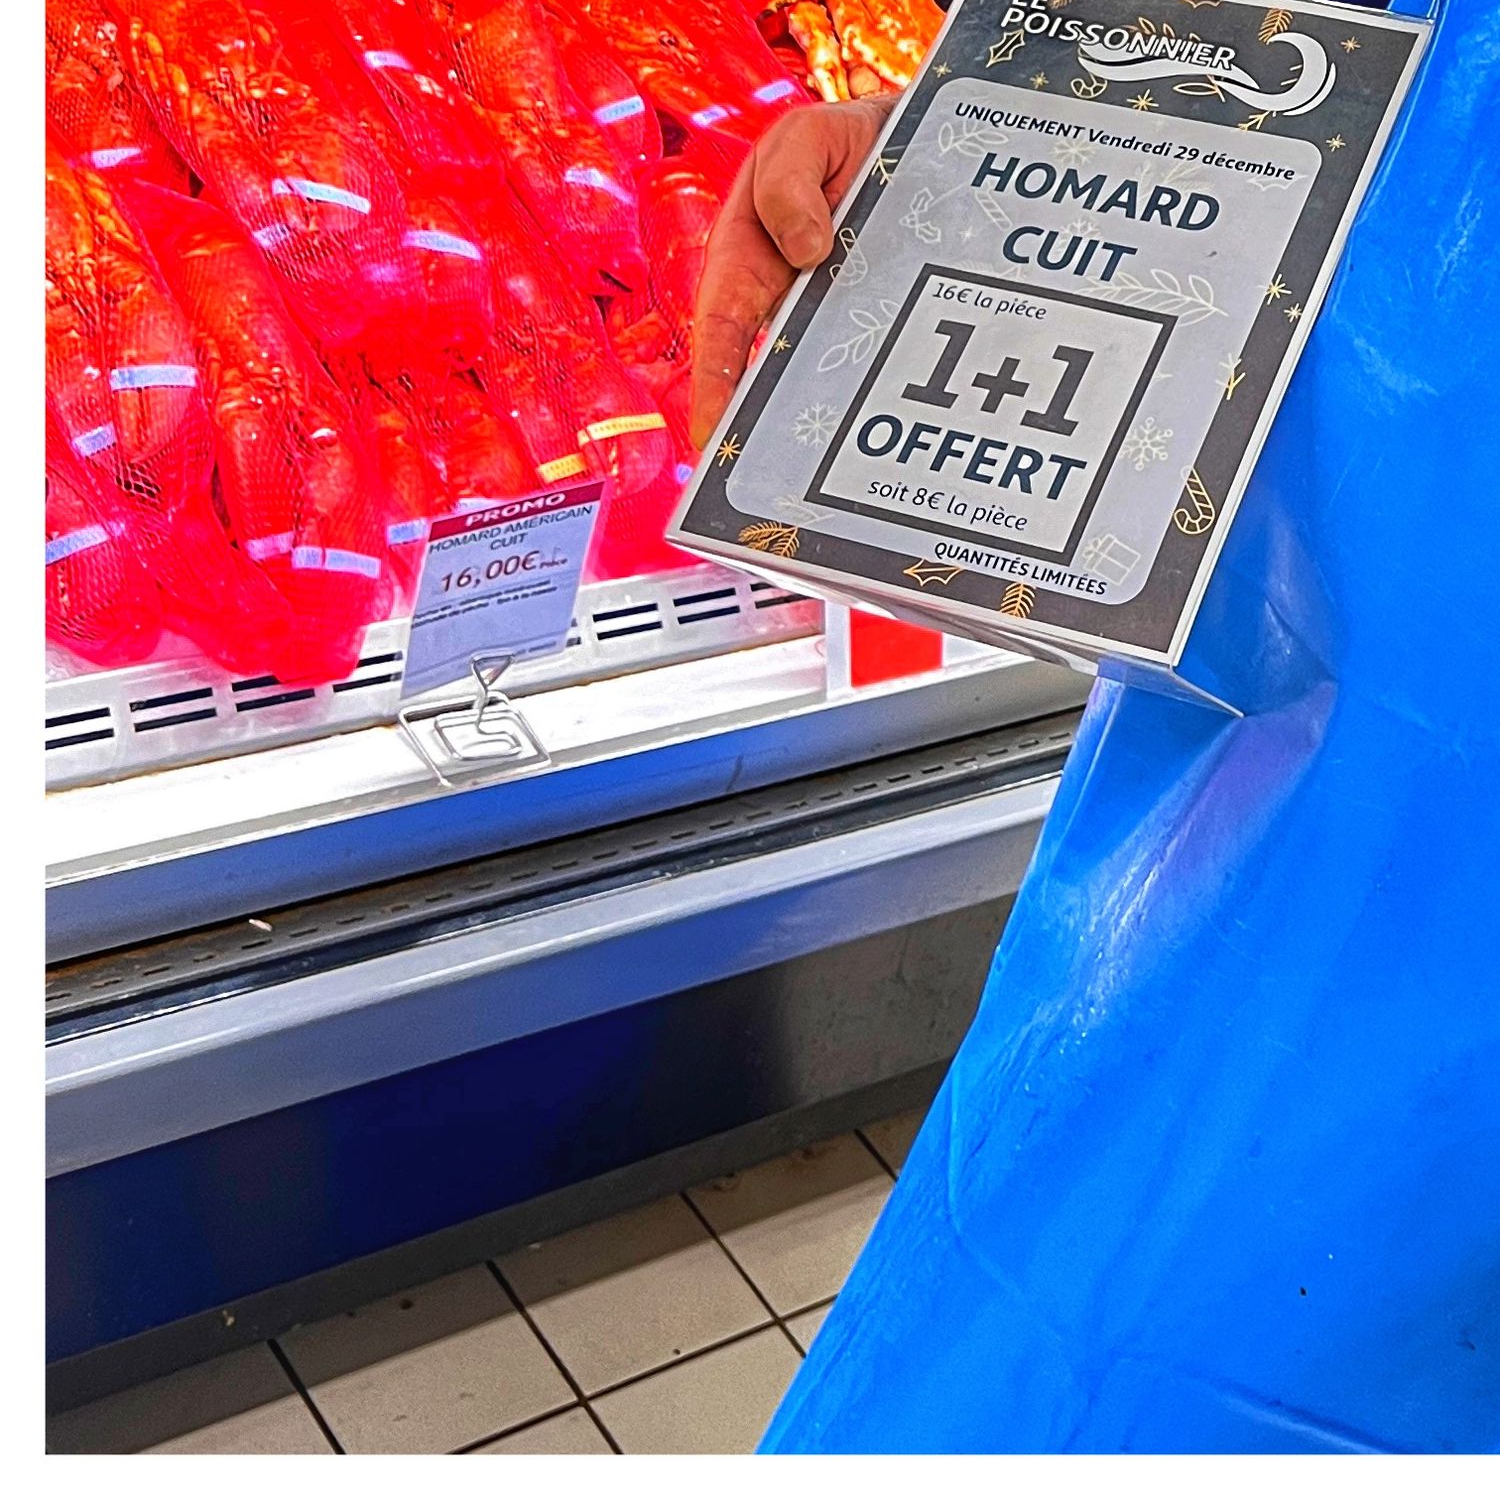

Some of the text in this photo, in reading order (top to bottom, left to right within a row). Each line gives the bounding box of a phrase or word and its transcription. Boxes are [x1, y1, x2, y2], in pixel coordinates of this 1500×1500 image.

[1001, 6, 1236, 71] POISSONNIER
[954, 101, 1296, 182] UNIQUEMENT Vendredi 29 décembre
[971, 151, 1221, 232] HOMARD
[1002, 225, 1138, 283] CUIT
[932, 282, 972, 304] 16€
[974, 290, 993, 309] la
[900, 318, 1095, 437] 1+1
[856, 413, 1088, 501] OFFERT
[465, 493, 566, 527] PROMO
[867, 480, 1029, 532] soit 8€ la pièce
[429, 526, 502, 555] HOMARD
[490, 532, 528, 551] CUIT
[442, 550, 540, 593] 16,00€
[934, 541, 1108, 596] QUANTITÉS LIMITÉES
